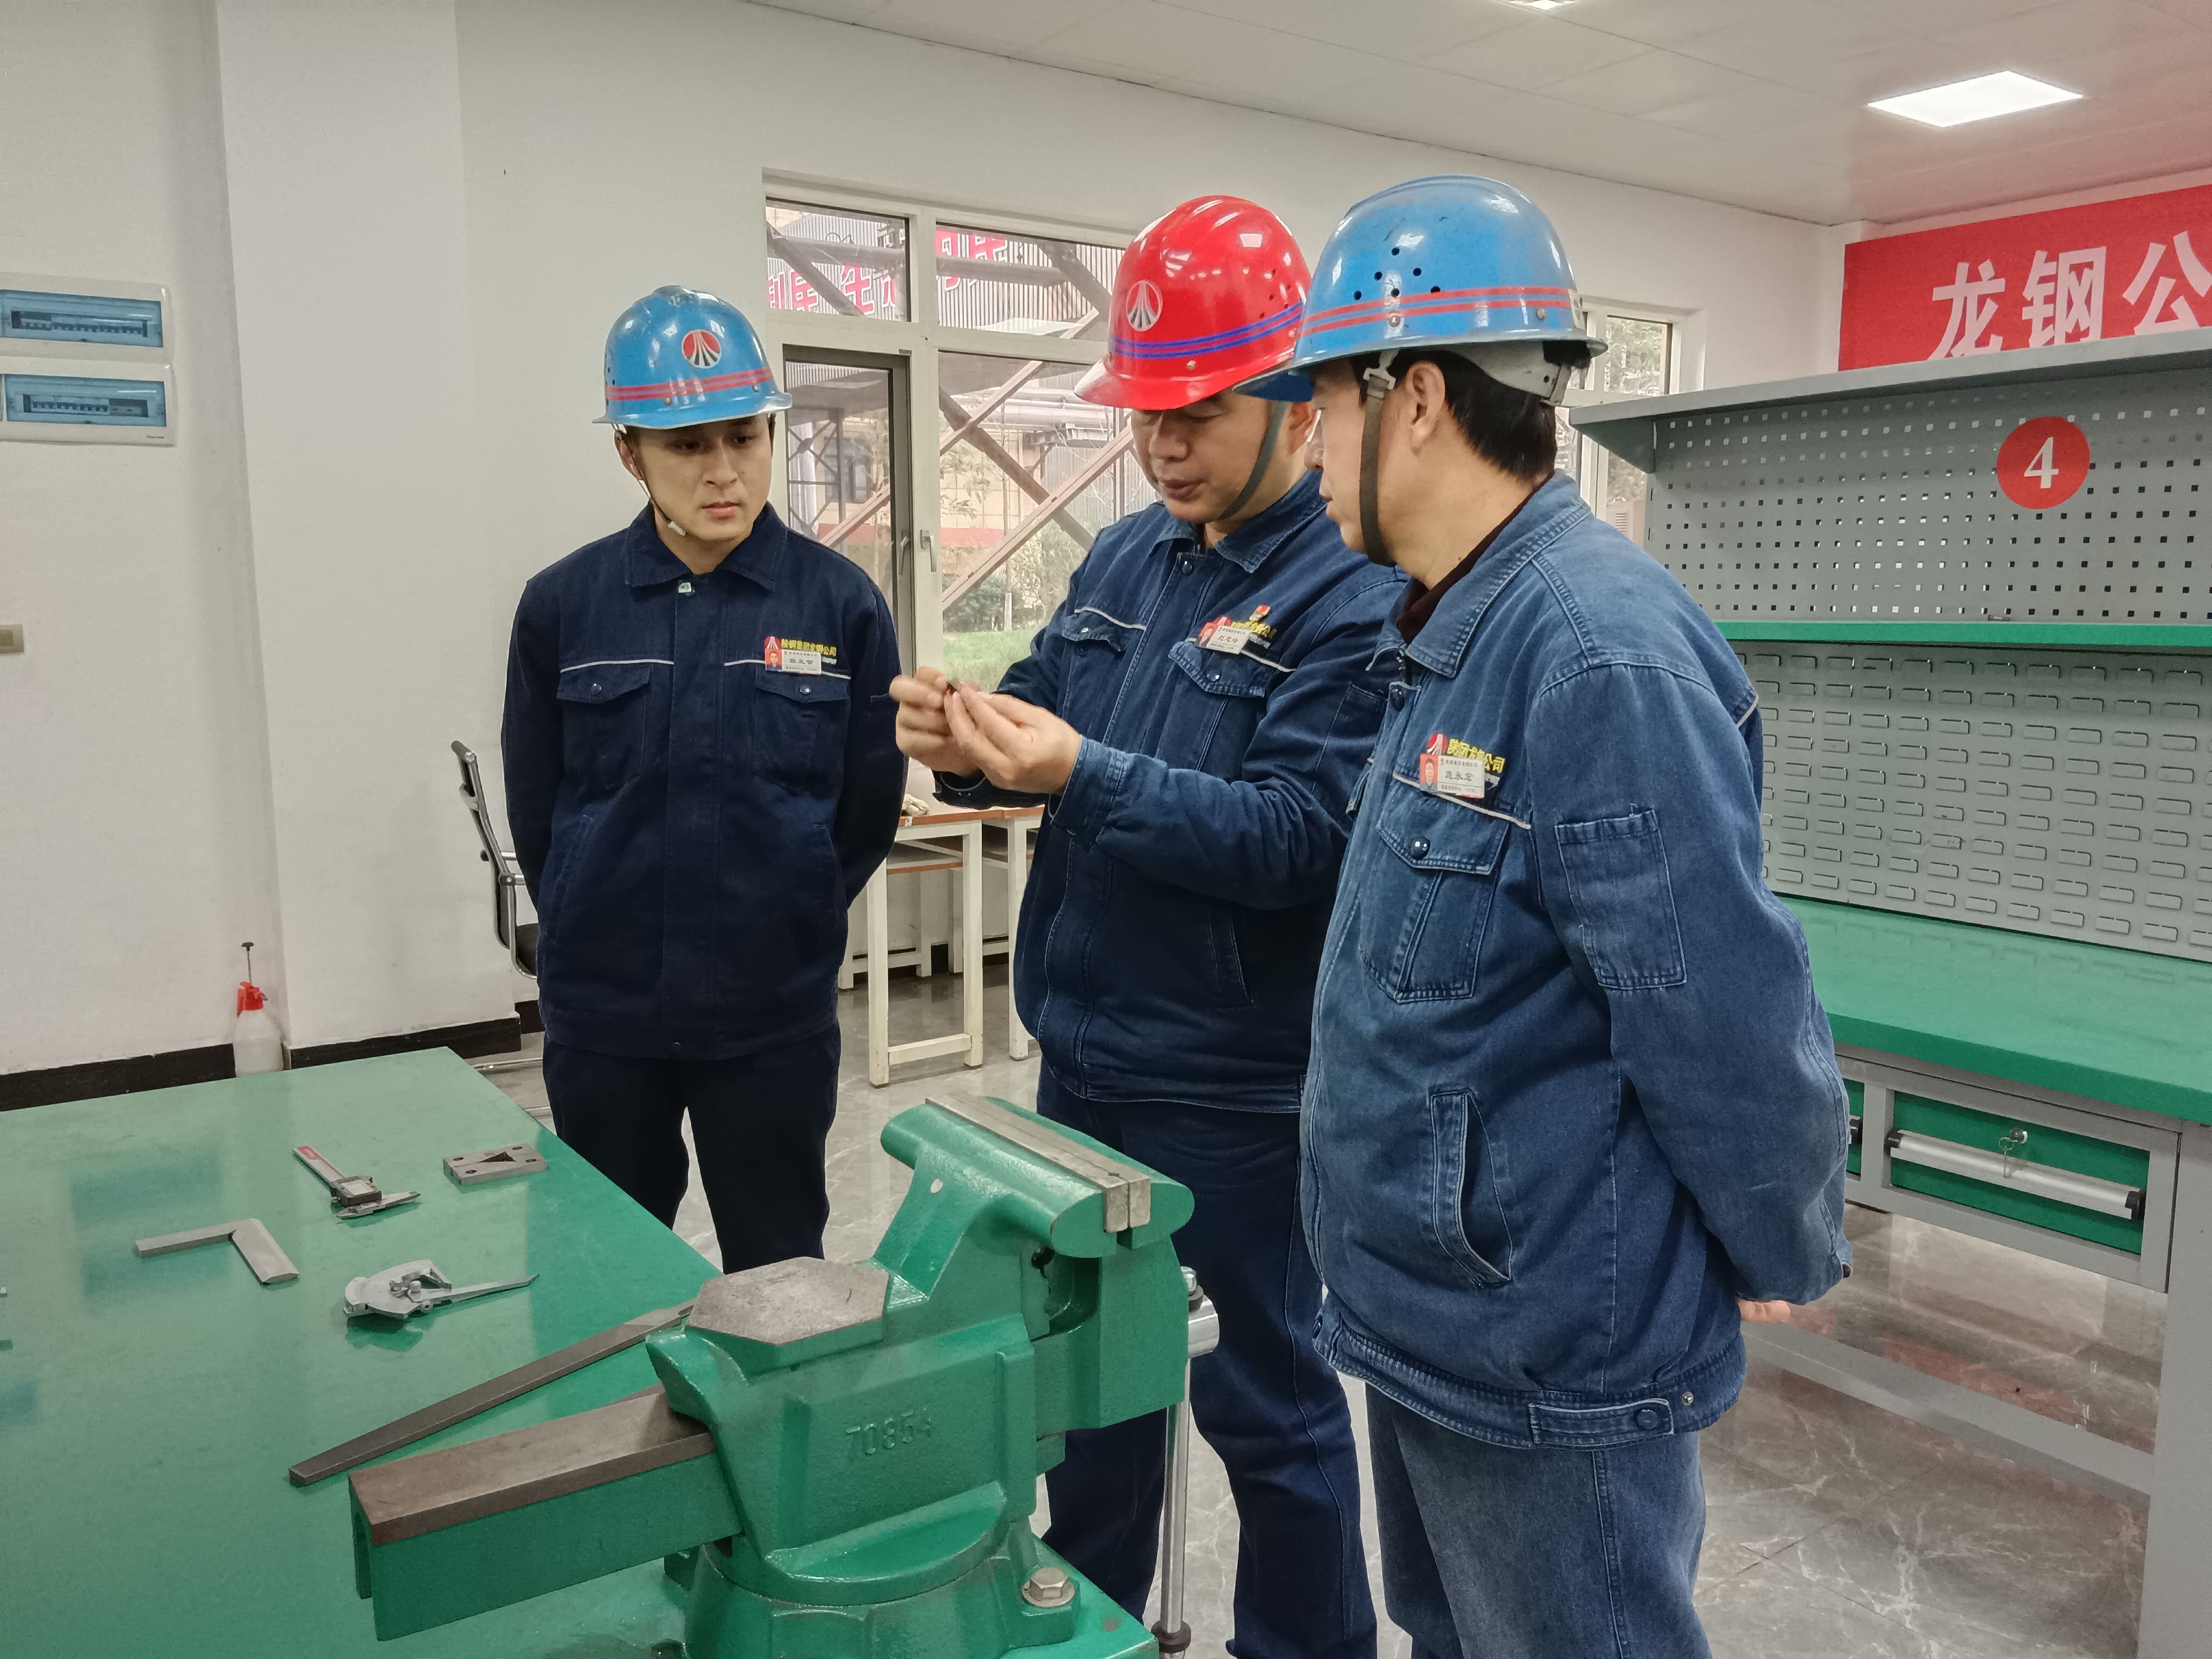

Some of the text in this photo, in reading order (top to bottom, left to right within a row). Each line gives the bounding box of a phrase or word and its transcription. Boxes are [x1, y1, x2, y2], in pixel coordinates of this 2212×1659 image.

[1927, 231, 2212, 361] 龙钢公
[2024, 437, 2059, 489] 4
[845, 1405, 933, 1456] 70854
